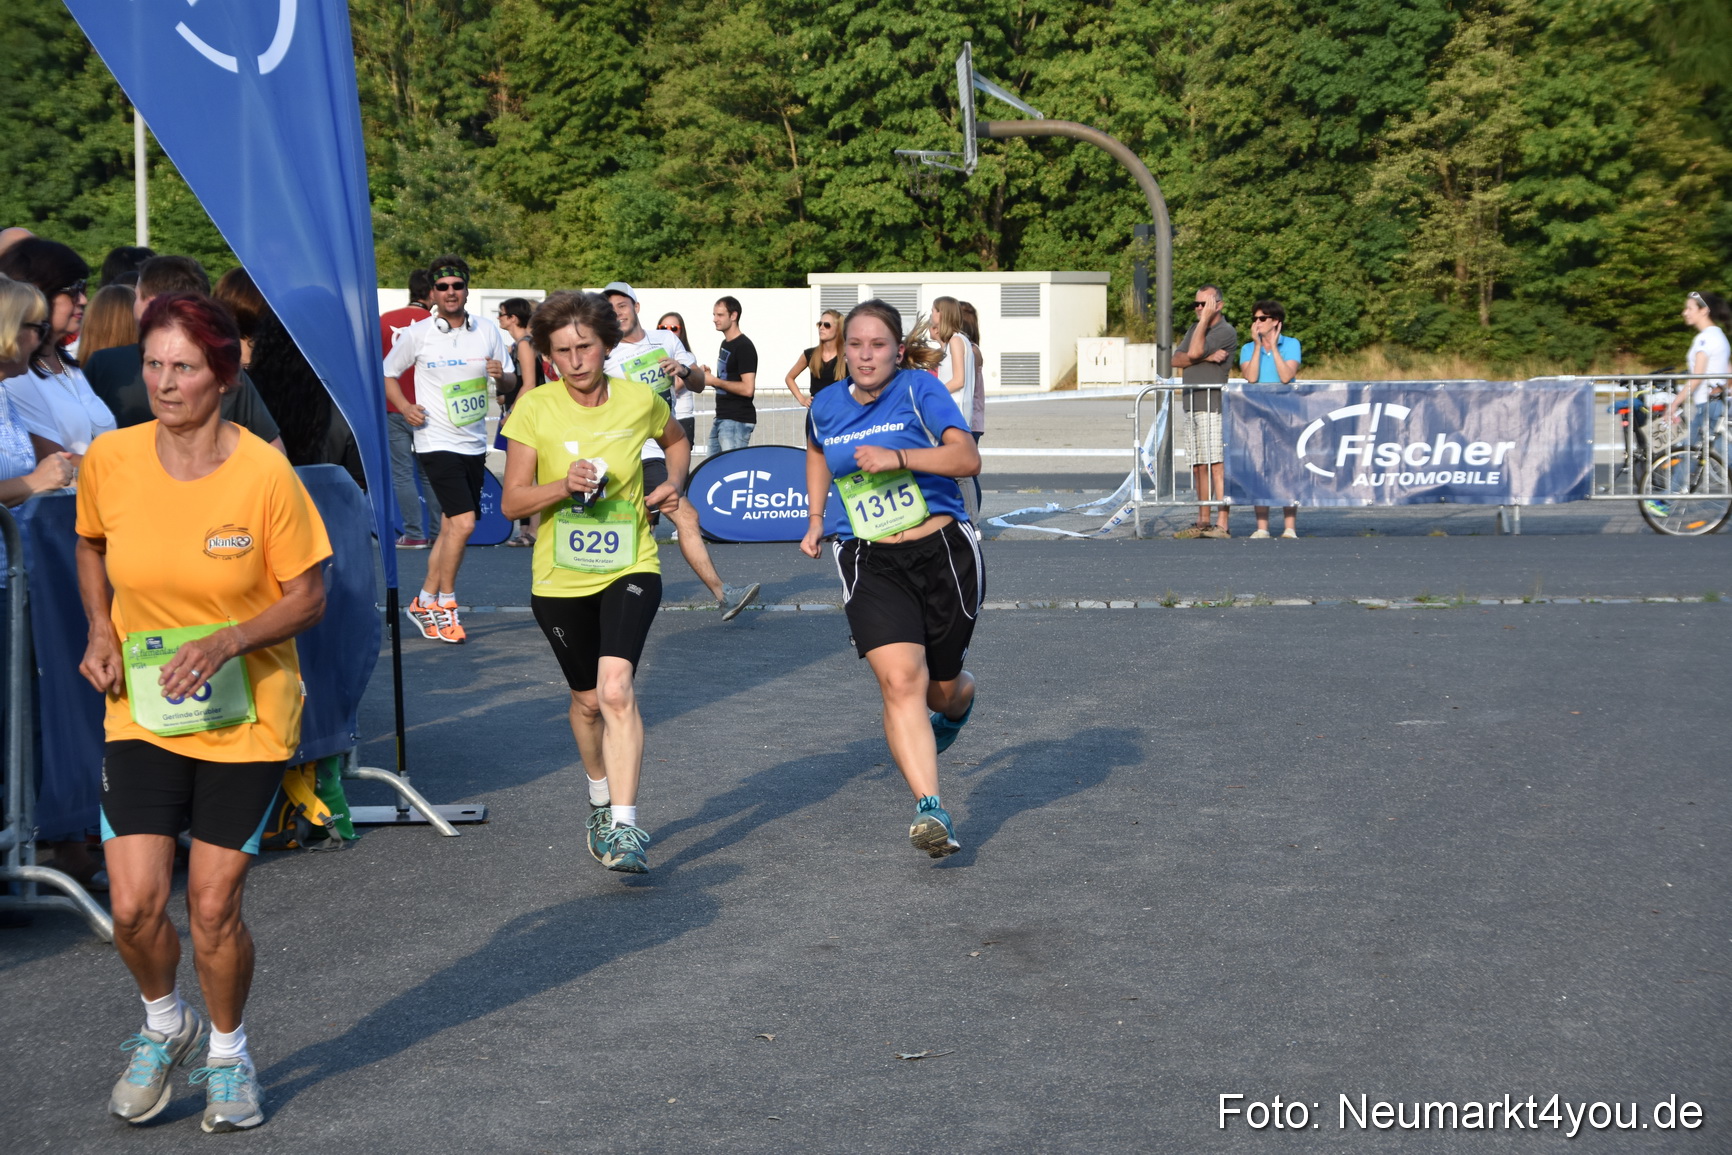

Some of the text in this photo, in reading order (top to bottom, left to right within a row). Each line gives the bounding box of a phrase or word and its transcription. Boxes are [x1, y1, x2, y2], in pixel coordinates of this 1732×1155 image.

[640, 368, 666, 384] 524
[452, 394, 486, 414] 1306
[824, 422, 905, 446] energiegeladen
[1335, 432, 1516, 467] Fischer
[1352, 470, 1500, 487] AUTOMOBILE
[731, 487, 833, 509] Fisch
[855, 483, 915, 522] 1315
[742, 509, 827, 520] AUTOMOB
[209, 536, 238, 549] plank
[569, 530, 619, 554] 629
[162, 711, 193, 720] Gerlinde
